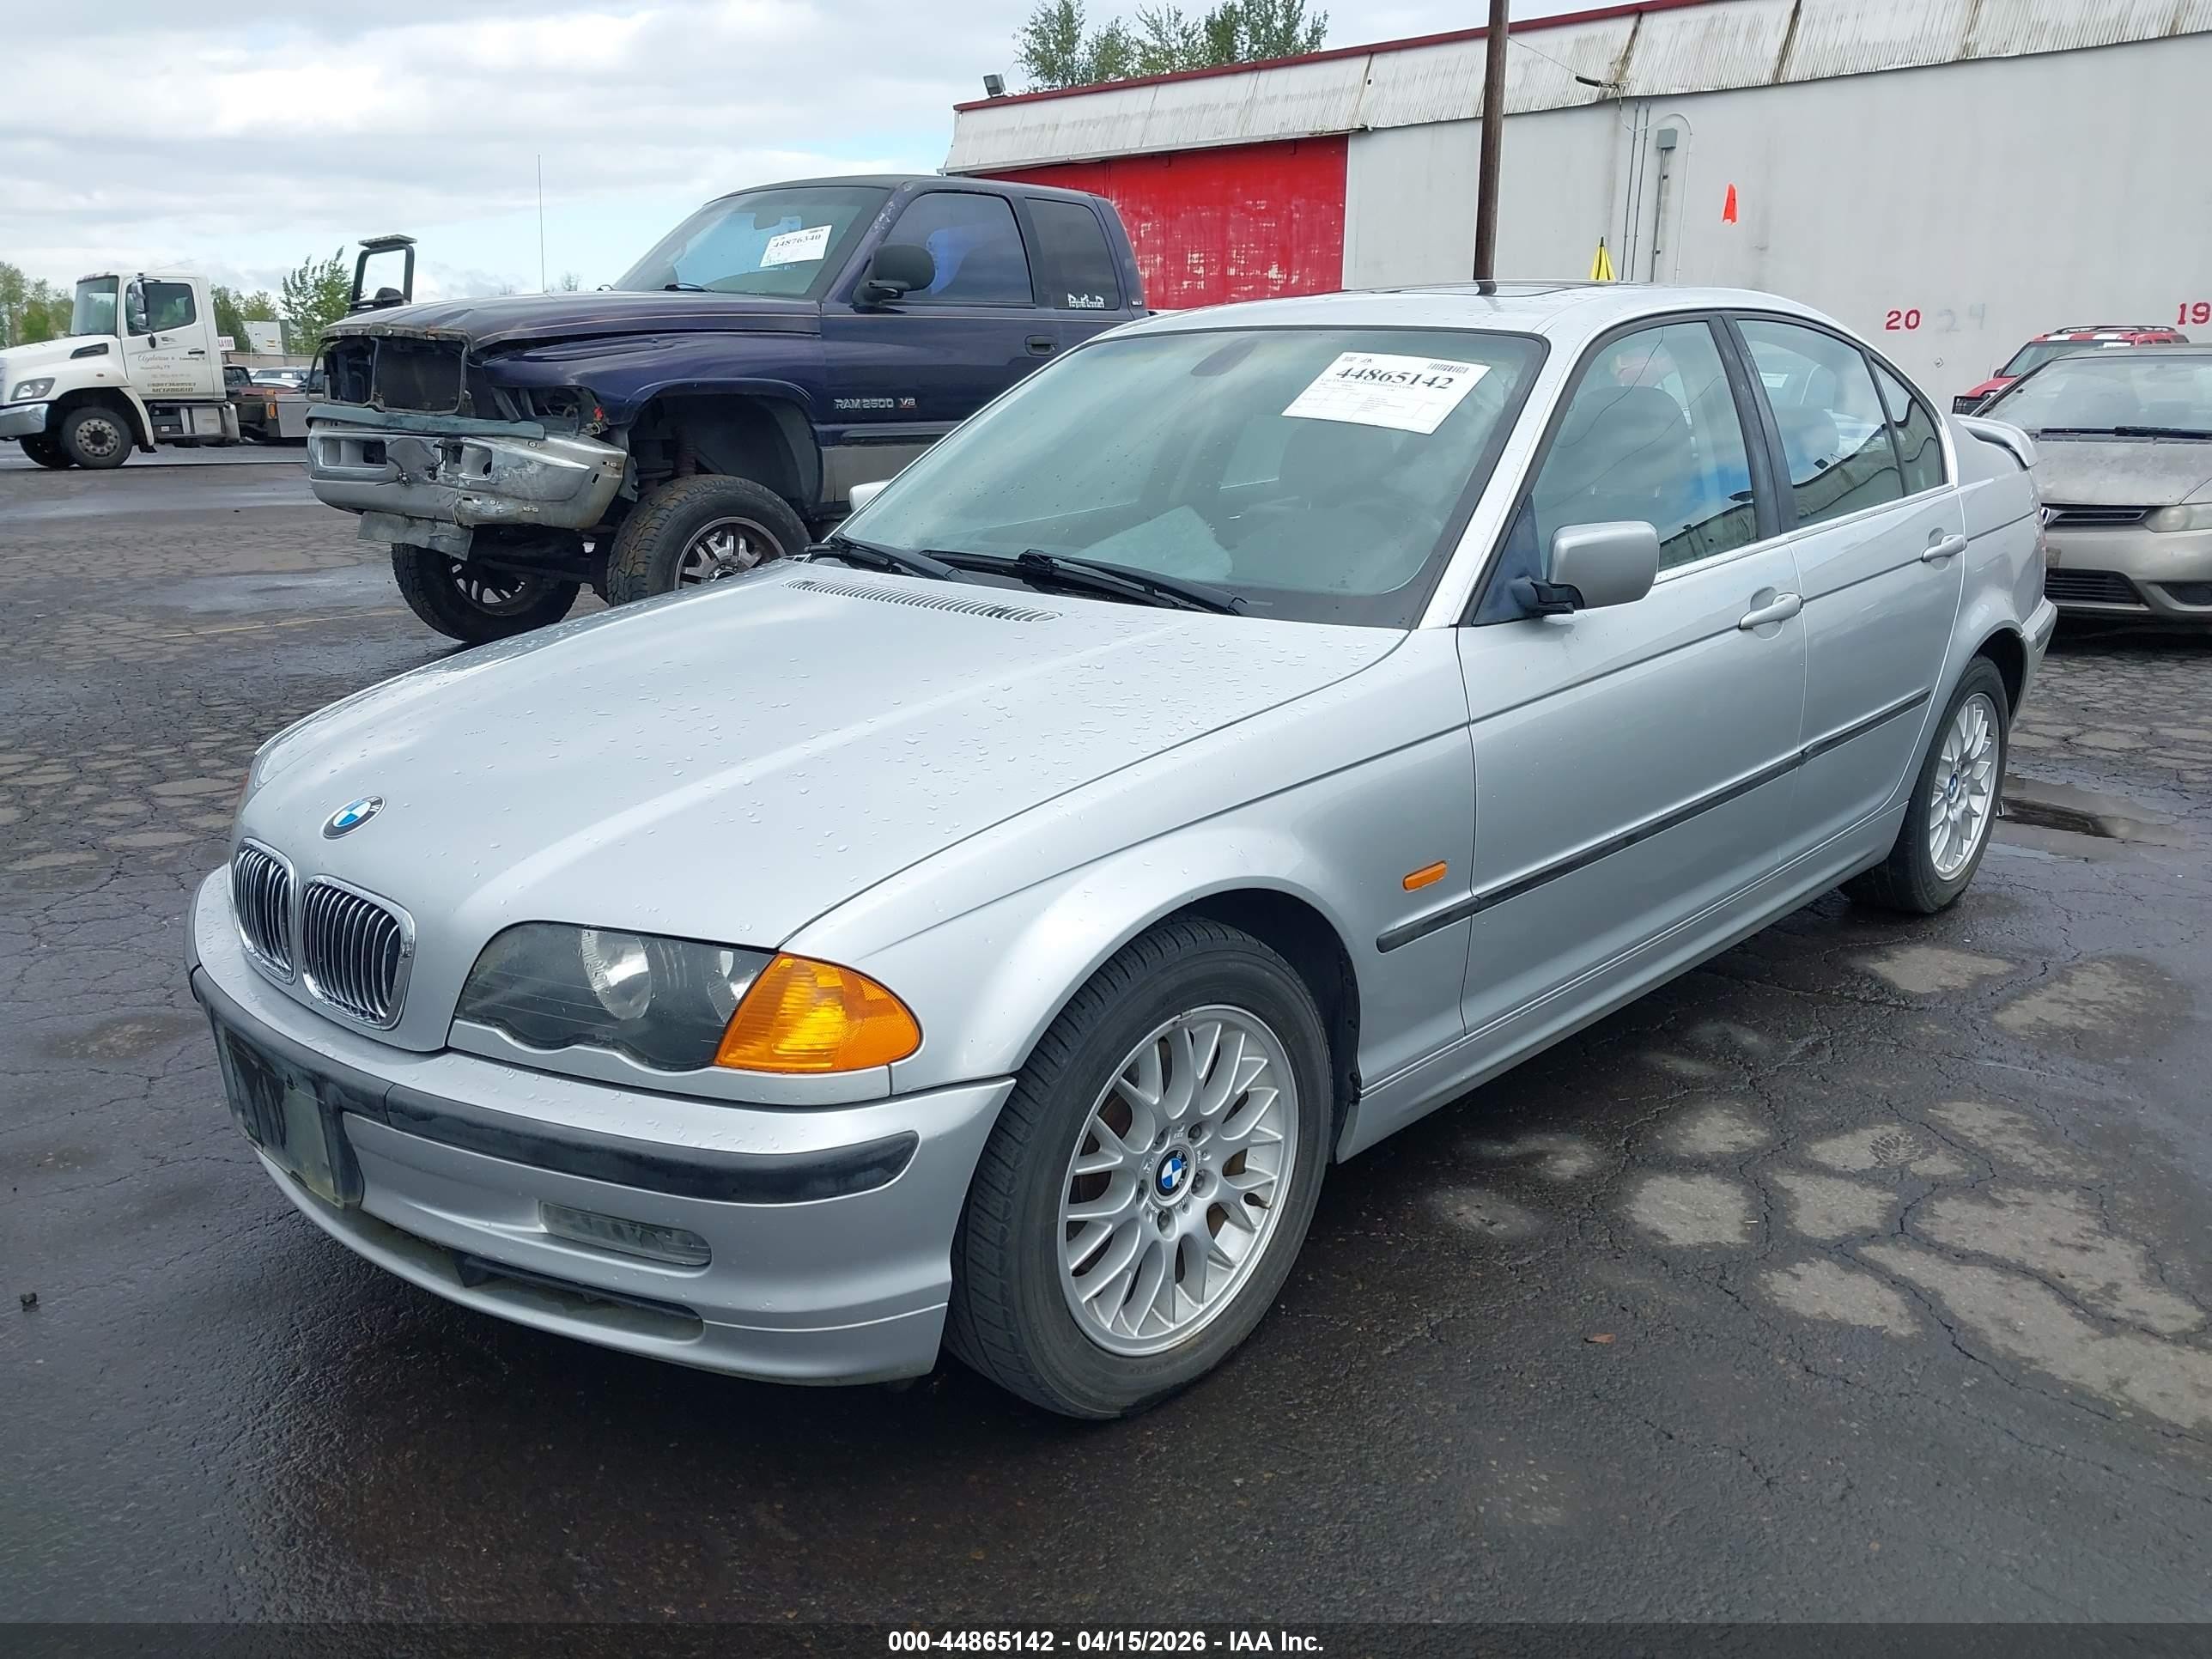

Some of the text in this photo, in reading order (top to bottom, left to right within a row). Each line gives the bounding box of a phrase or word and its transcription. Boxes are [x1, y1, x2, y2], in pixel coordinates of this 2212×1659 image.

[1885, 309, 1921, 331] 20
[2177, 301, 2212, 325] 19
[1336, 366, 1455, 390] 44865142
[834, 398, 915, 410] RAM 2500 V8
